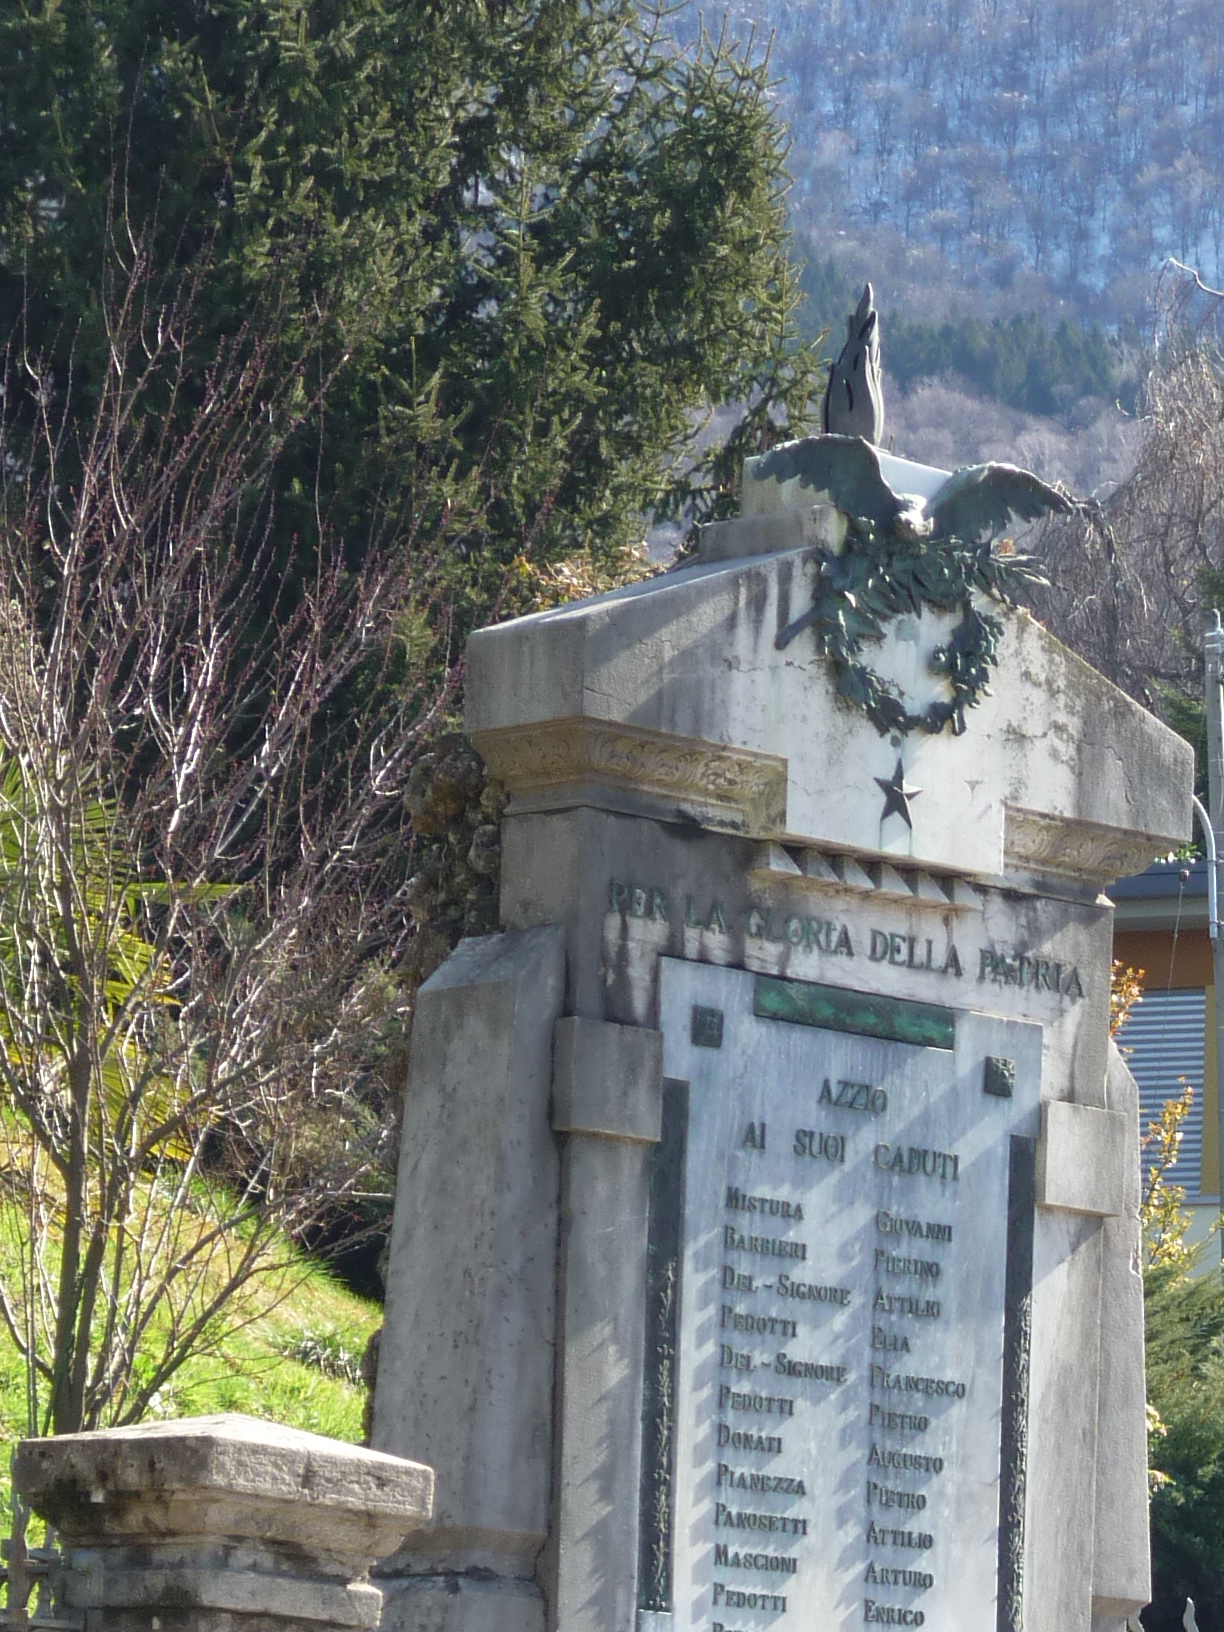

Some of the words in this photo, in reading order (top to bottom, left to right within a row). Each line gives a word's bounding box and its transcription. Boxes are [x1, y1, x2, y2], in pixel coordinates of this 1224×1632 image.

[608, 877, 668, 922] PER
[686, 894, 729, 934] LA
[746, 906, 855, 956] GLORIA
[869, 928, 963, 977] DELLA
[978, 947, 1086, 998] PATRIA
[817, 1078, 888, 1114] AZZIO
[742, 1122, 767, 1150] AI
[793, 1128, 846, 1162] SUOI
[874, 1142, 960, 1181] CADUTI
[724, 1186, 804, 1221] MISTURA
[876, 1210, 953, 1242] GIOVANNI
[723, 1225, 807, 1261] BARBIERI
[874, 1248, 941, 1280] PIERINO
[873, 1287, 941, 1319] ATTILIO
[871, 1327, 911, 1354] ELIA
[870, 1365, 966, 1399] FRANCESCO
[869, 1403, 929, 1432] PIETRO
[717, 1422, 783, 1453] DONATI
[867, 1442, 944, 1474] AUGUSTO
[716, 1463, 807, 1496] PIANEZZA
[866, 1480, 927, 1510] PIETRO
[866, 1521, 933, 1550] ATTILIO
[714, 1543, 798, 1574] MASCIONI
[864, 1561, 934, 1589] ARTURO
[712, 1582, 788, 1612] PEDOTTI
[863, 1599, 925, 1627] ENRICO
